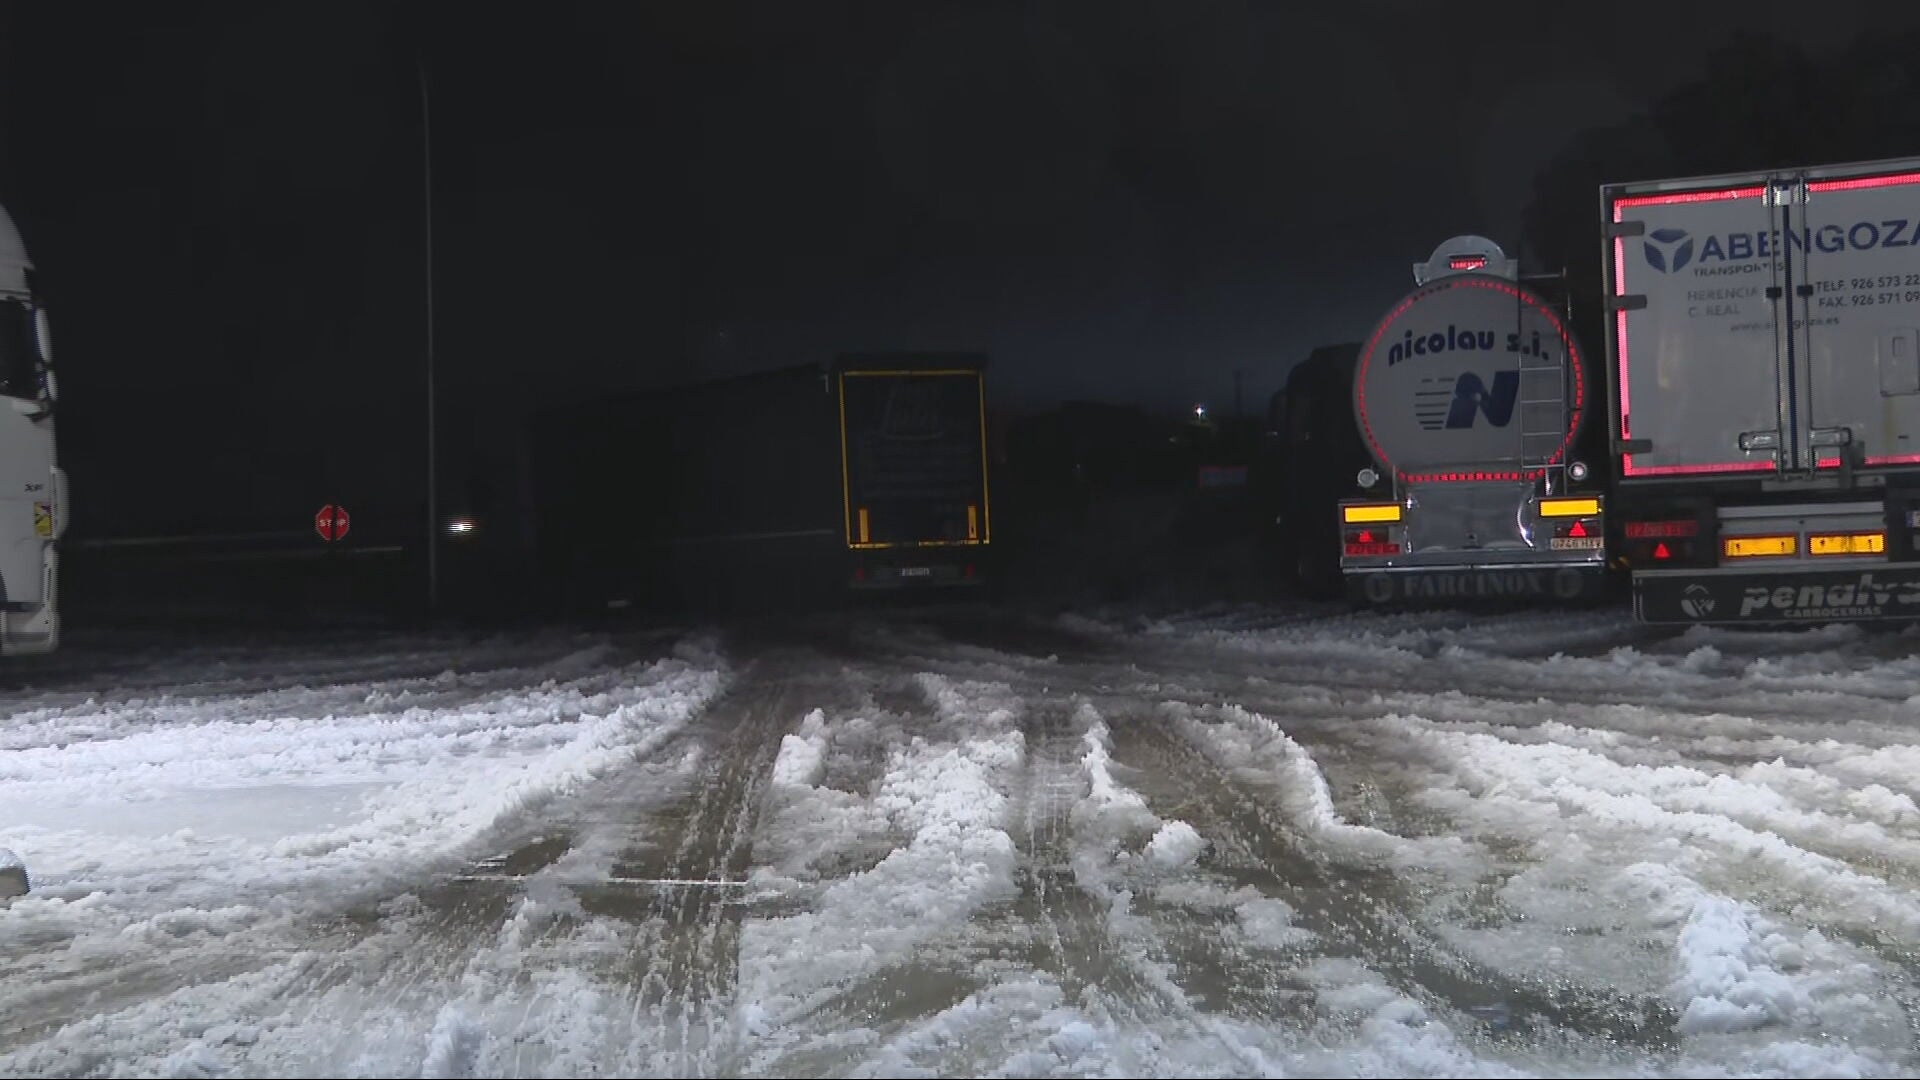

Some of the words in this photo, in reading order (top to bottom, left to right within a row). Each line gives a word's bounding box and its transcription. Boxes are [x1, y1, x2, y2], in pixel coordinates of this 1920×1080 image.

[1851, 278, 1874, 290] 926
[1878, 275, 1900, 287] 573
[1851, 294, 1874, 307] 926
[1878, 293, 1900, 305] 571
[1388, 325, 1495, 367] nicolau
[1403, 571, 1545, 597] FARCINOX
